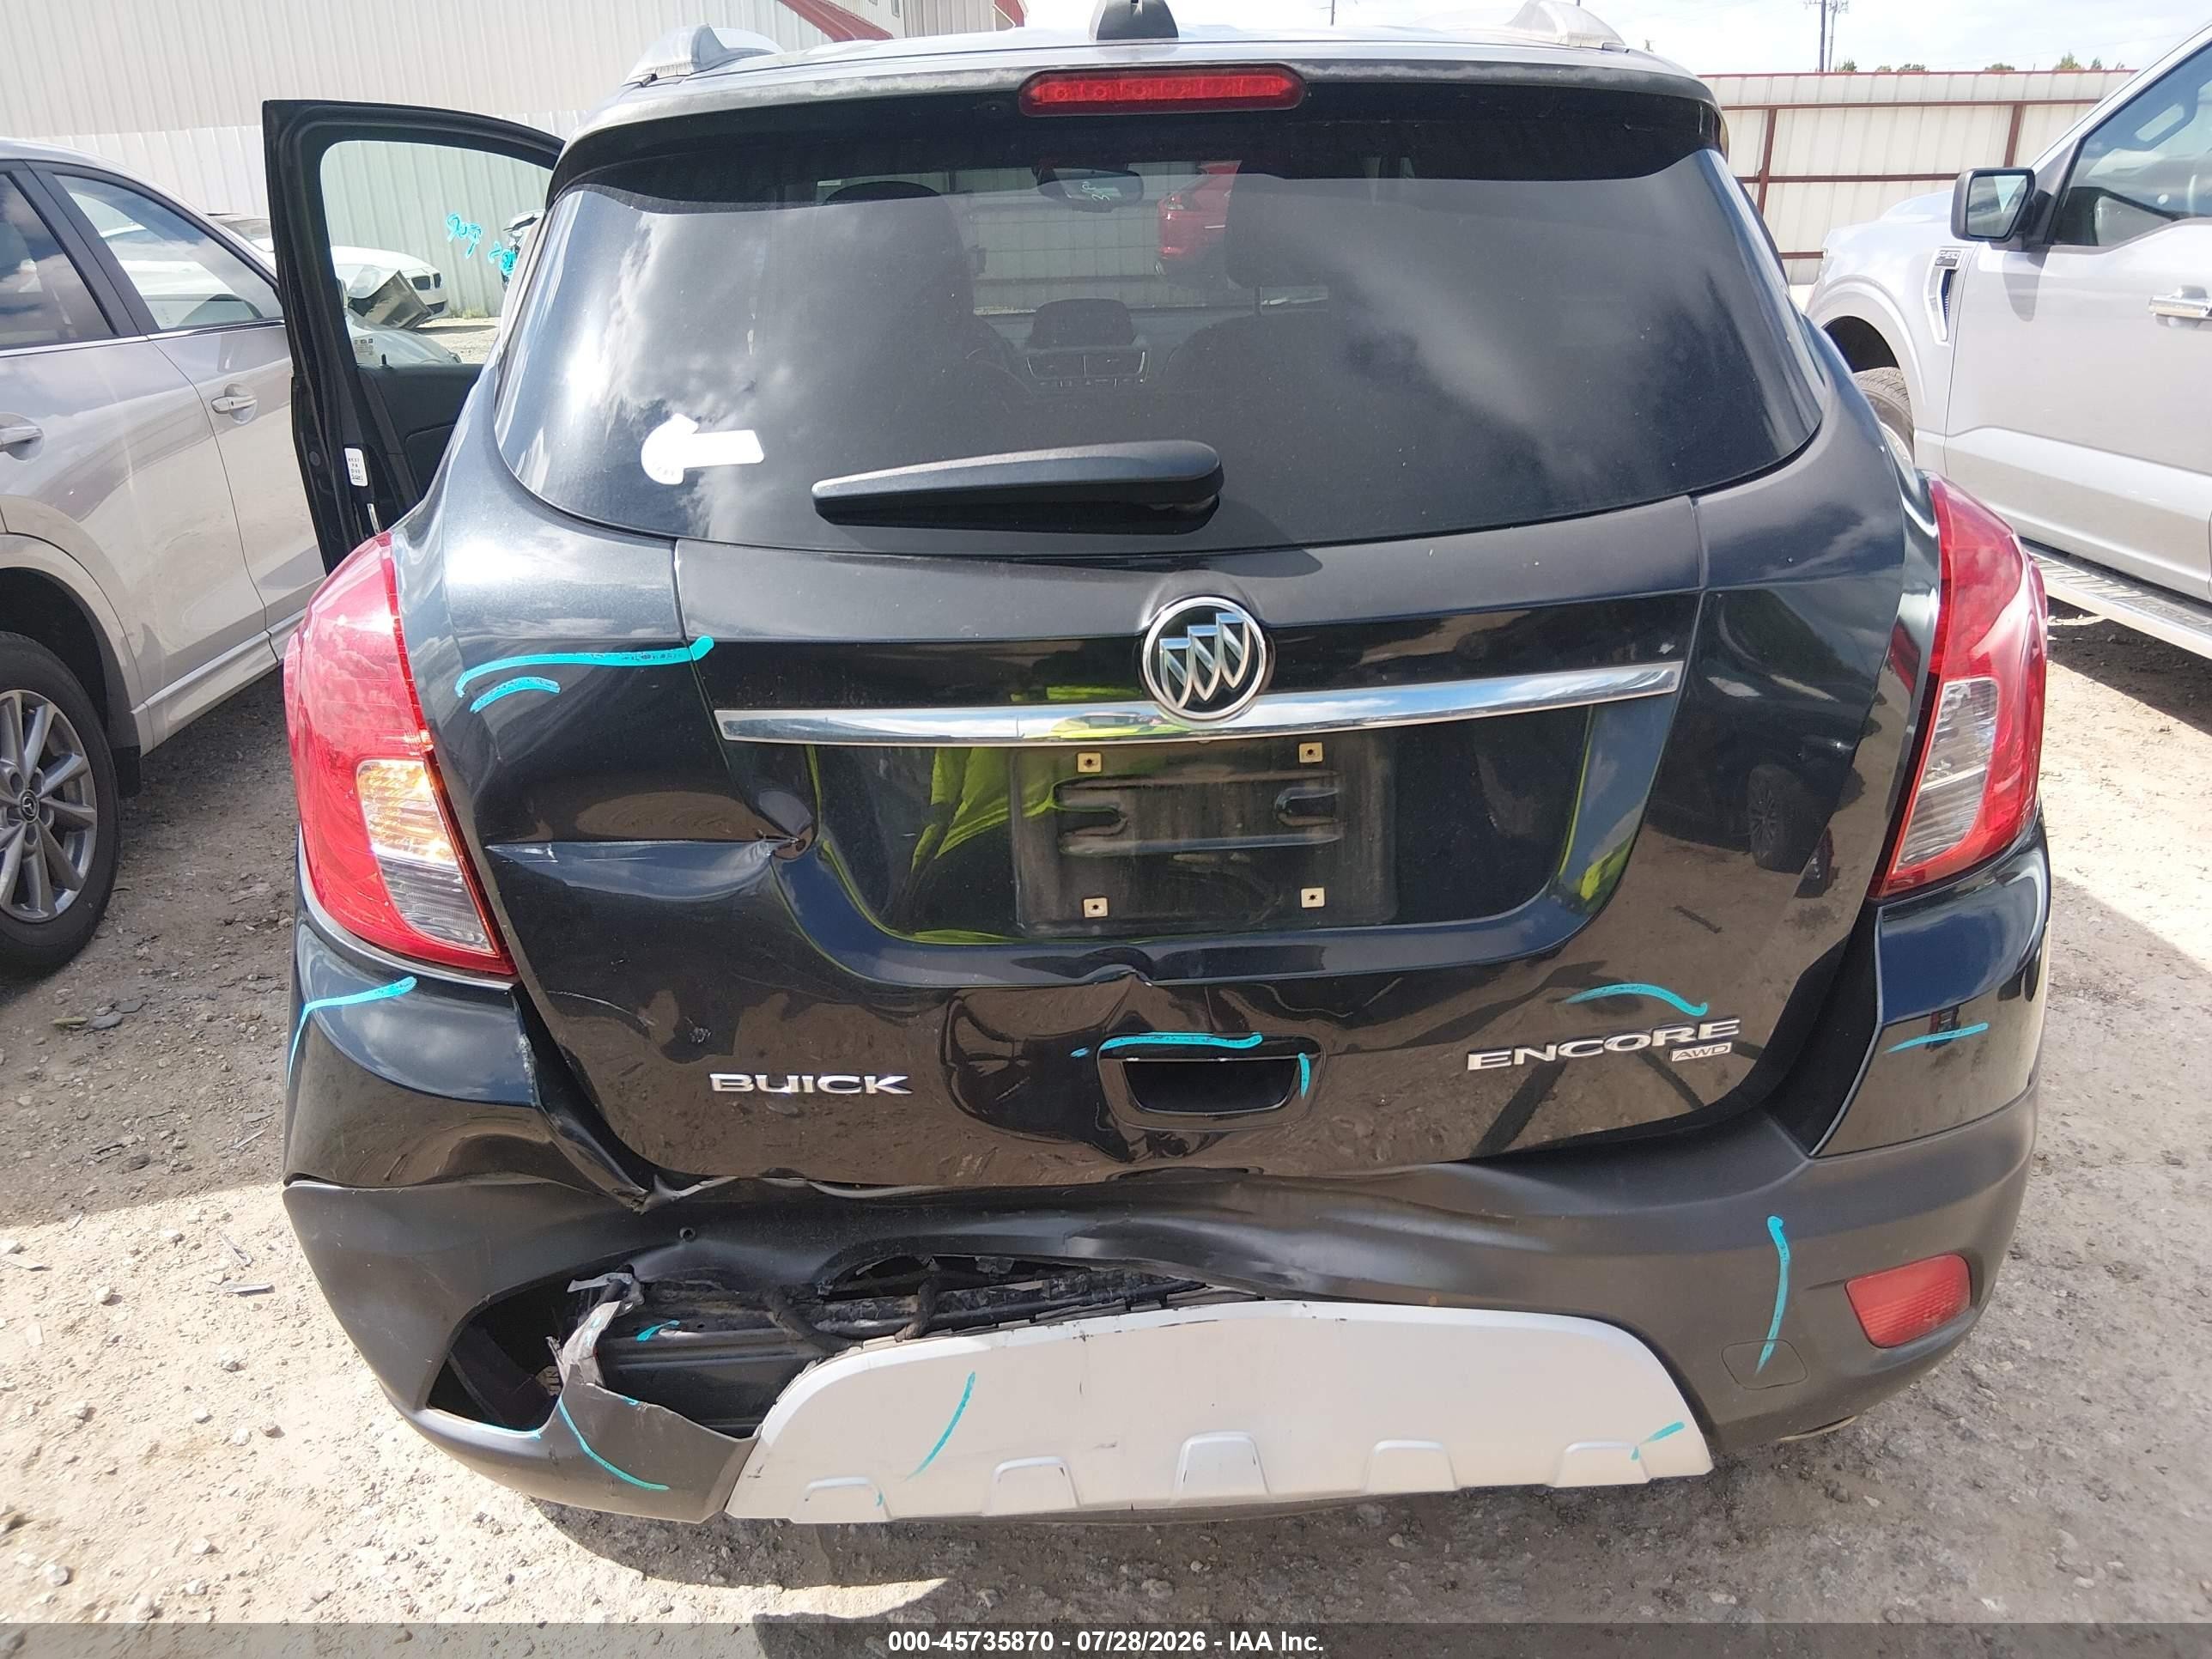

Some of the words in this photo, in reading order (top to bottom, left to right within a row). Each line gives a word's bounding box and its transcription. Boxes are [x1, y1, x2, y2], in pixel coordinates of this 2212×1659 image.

[1467, 1018, 1741, 1071] ENCORE
[1673, 1043, 1729, 1060] AWD
[709, 1073, 914, 1095] BUICK
